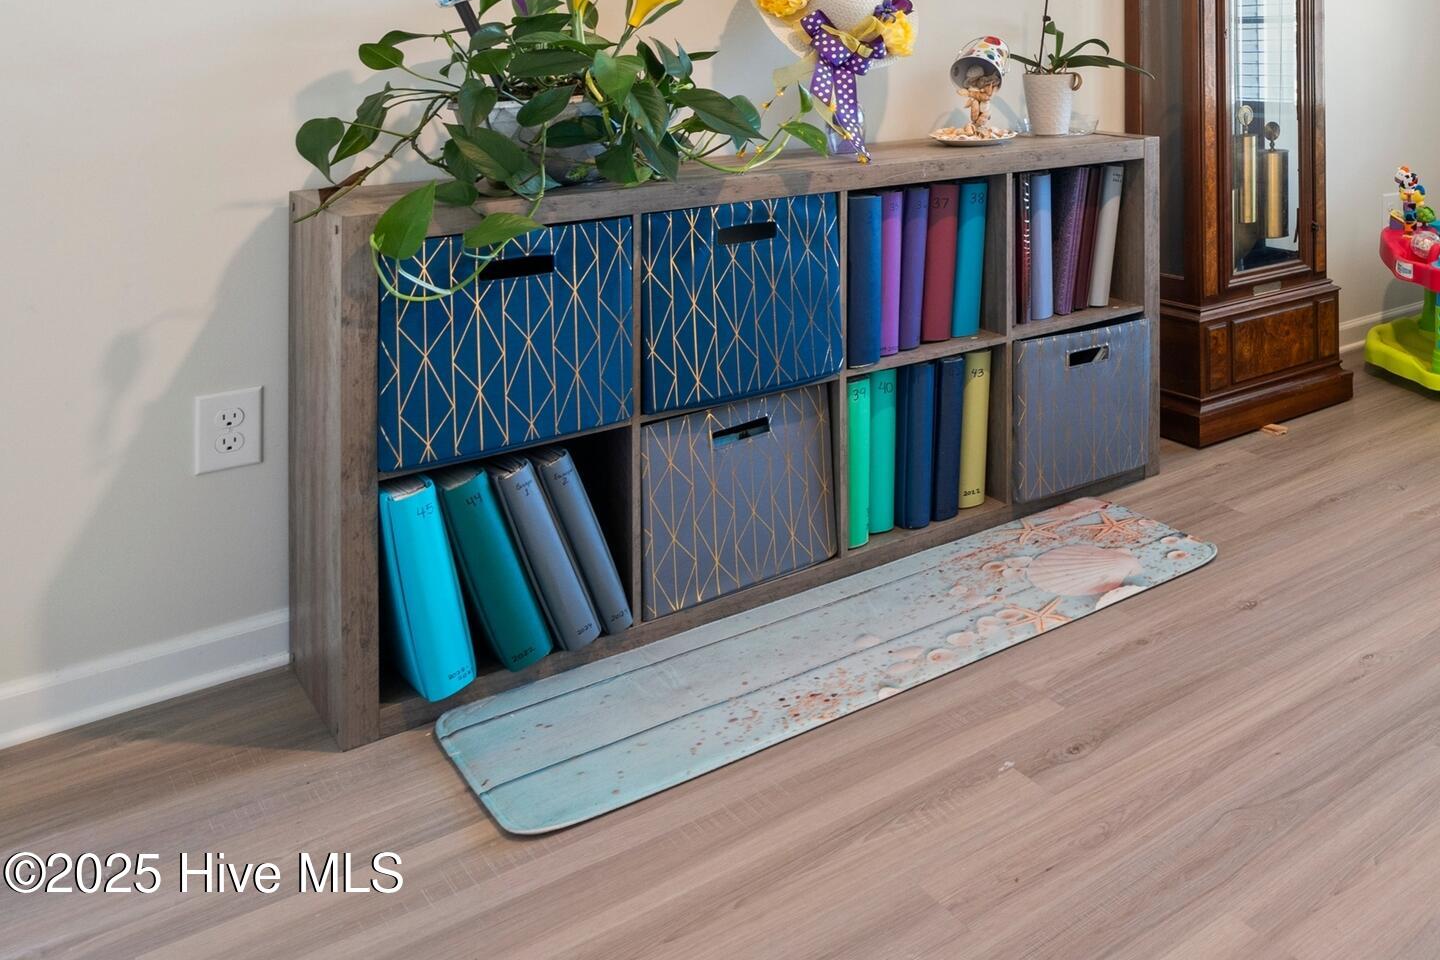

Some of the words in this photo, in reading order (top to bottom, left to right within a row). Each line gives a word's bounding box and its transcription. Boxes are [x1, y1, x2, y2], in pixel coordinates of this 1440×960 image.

[932, 197, 950, 209] 37
[970, 192, 985, 205] 38
[971, 368, 985, 379] 43
[877, 381, 894, 394] 40
[852, 387, 867, 402] 39
[465, 492, 483, 507] 44
[416, 503, 434, 519] 45
